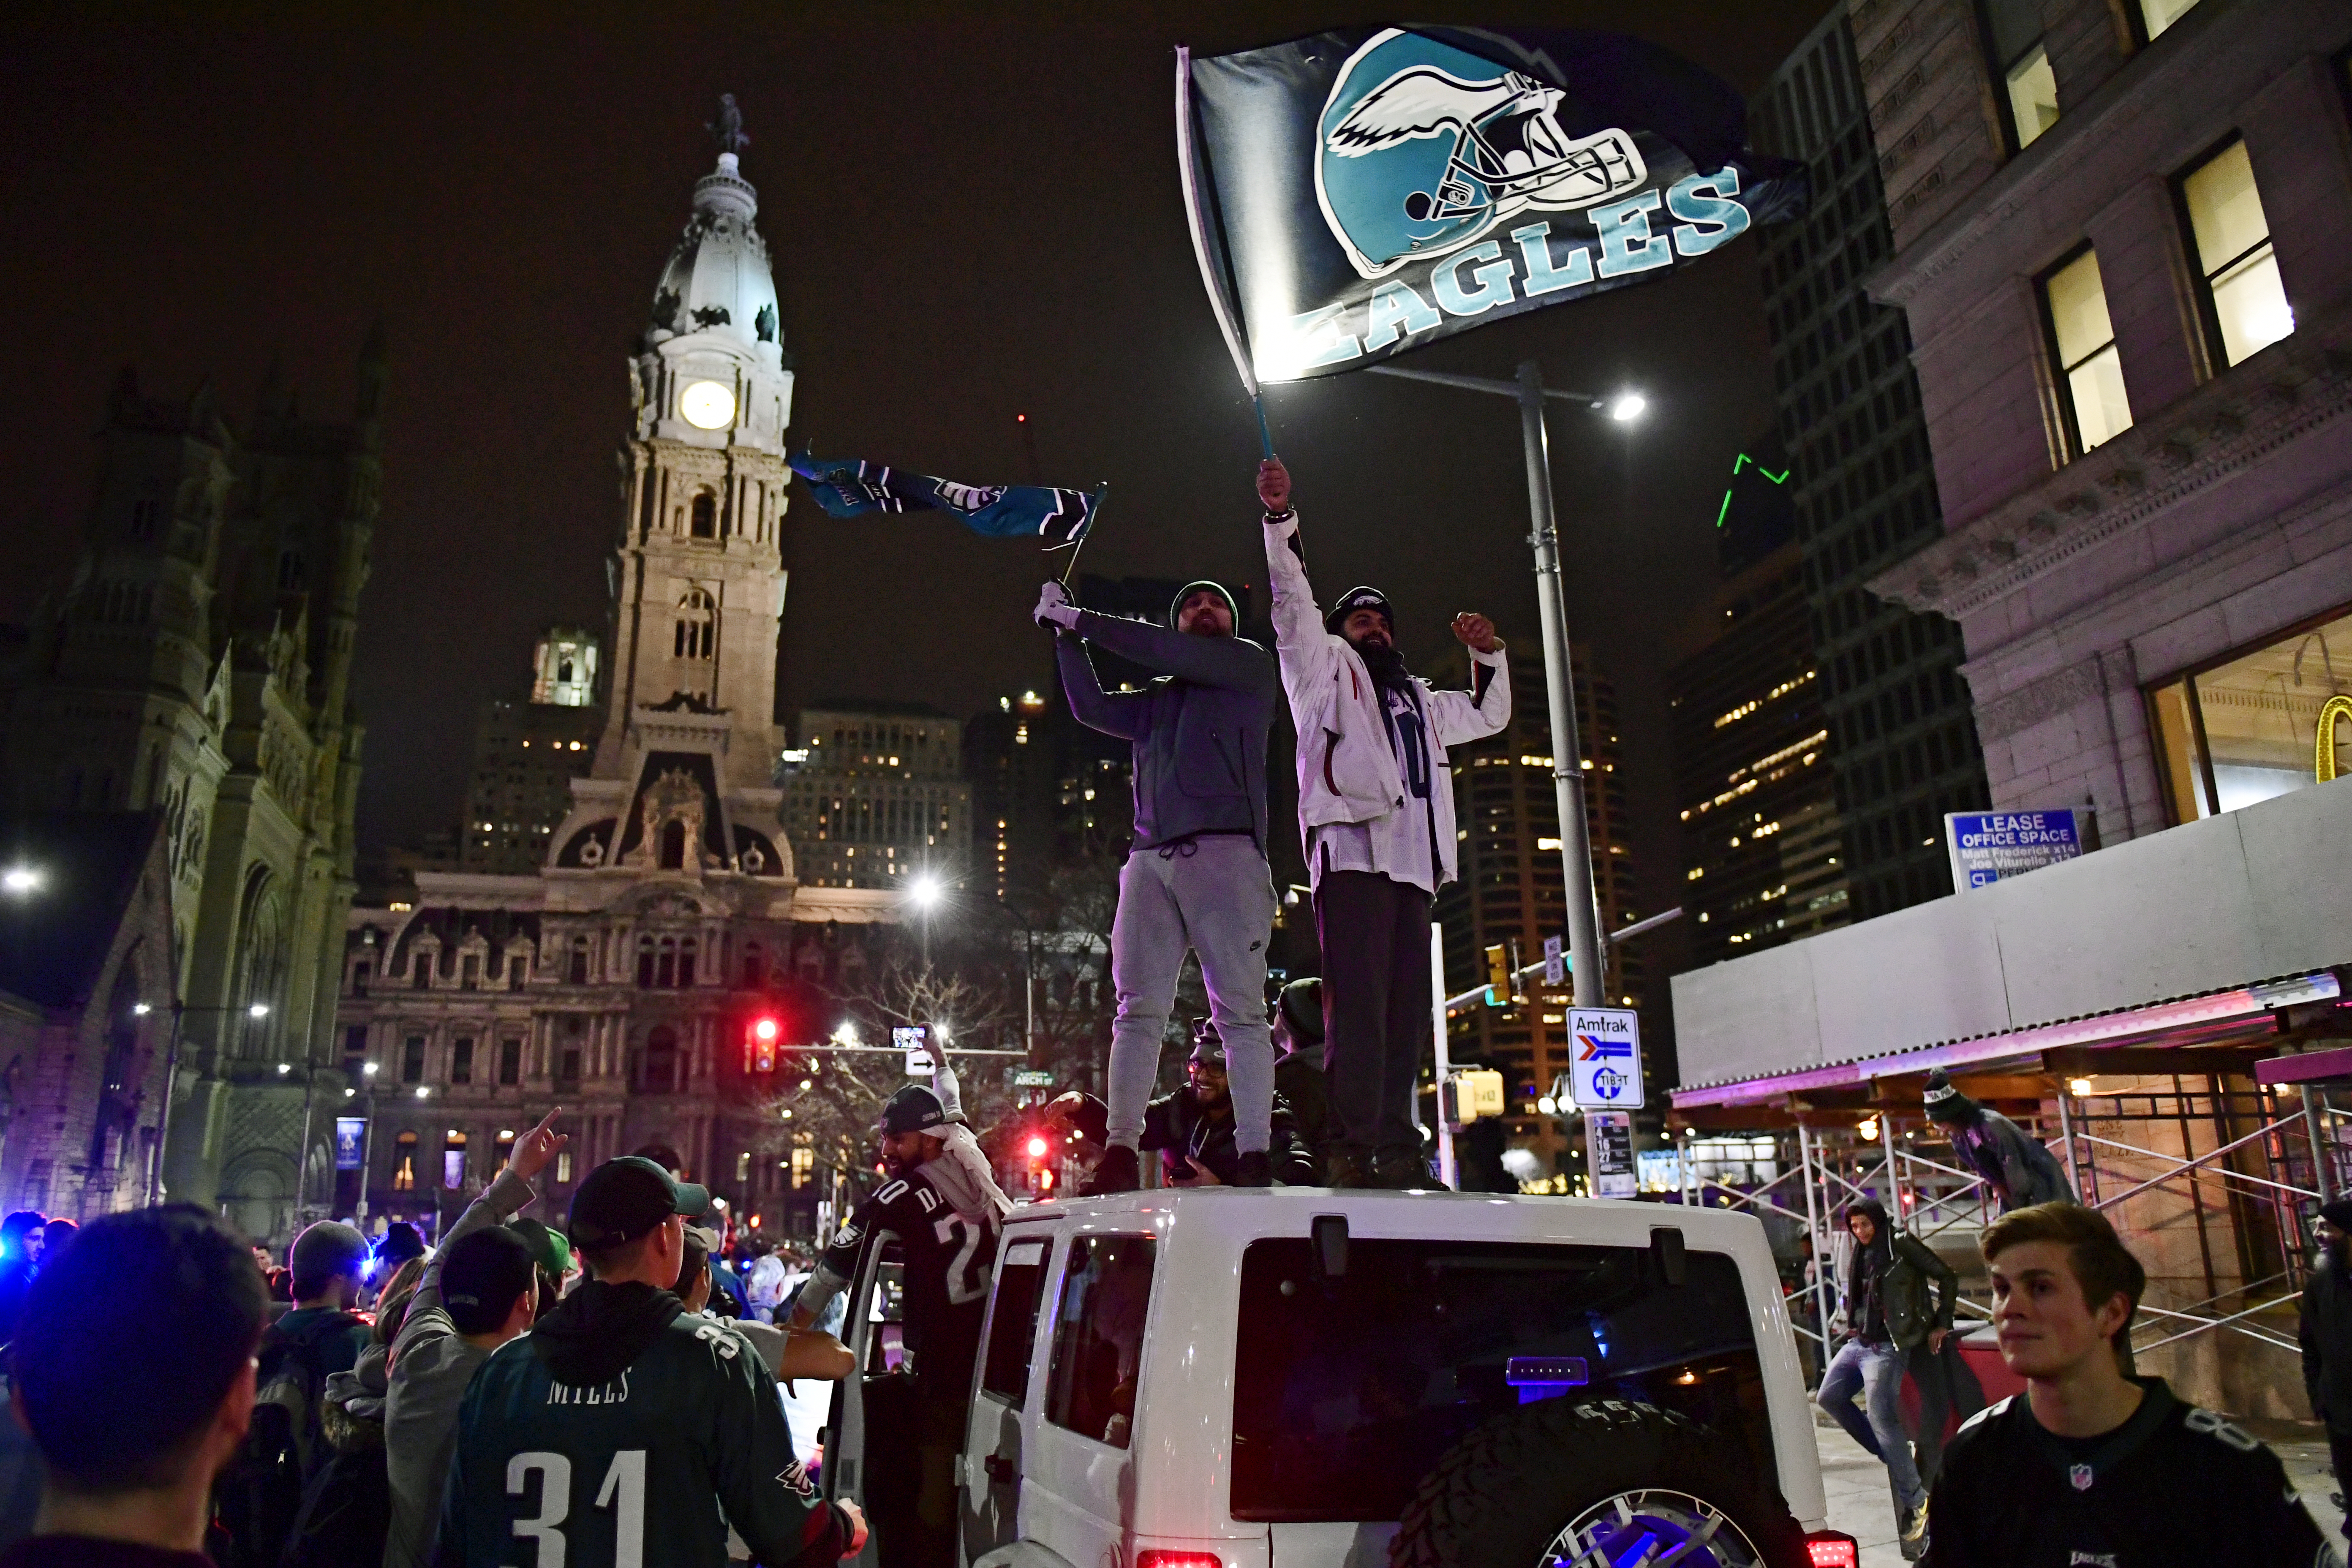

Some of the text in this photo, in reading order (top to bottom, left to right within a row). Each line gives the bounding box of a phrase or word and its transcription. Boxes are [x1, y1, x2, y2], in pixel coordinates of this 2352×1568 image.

[1289, 166, 1751, 369] EAGLES
[1982, 814, 2046, 833] LEASE
[1962, 829, 2070, 847] OFFICE SPACE
[1969, 859, 1993, 869] Joe
[1576, 1016, 1628, 1033] Amtrak
[1014, 1075, 1043, 1085] ARCH
[1598, 1139, 1610, 1152] 16
[1599, 1151, 1610, 1163] 27
[547, 1366, 632, 1404] MILLS
[499, 1450, 646, 1568] 31
